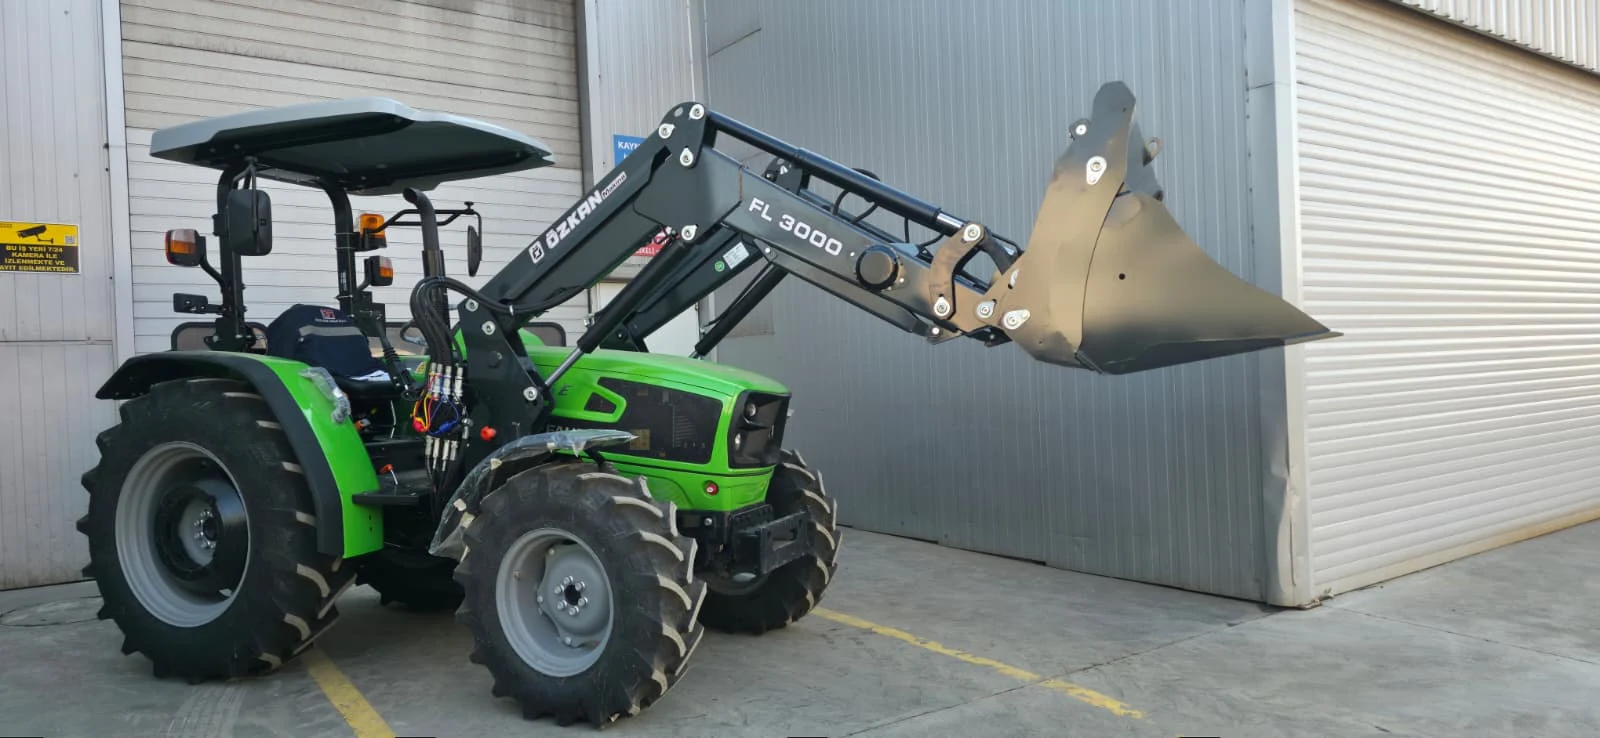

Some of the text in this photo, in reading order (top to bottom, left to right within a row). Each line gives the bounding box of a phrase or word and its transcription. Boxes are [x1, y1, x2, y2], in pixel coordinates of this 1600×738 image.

[545, 189, 603, 249] ÖZKAN
[748, 197, 773, 222] FL
[778, 213, 843, 256] 3000
